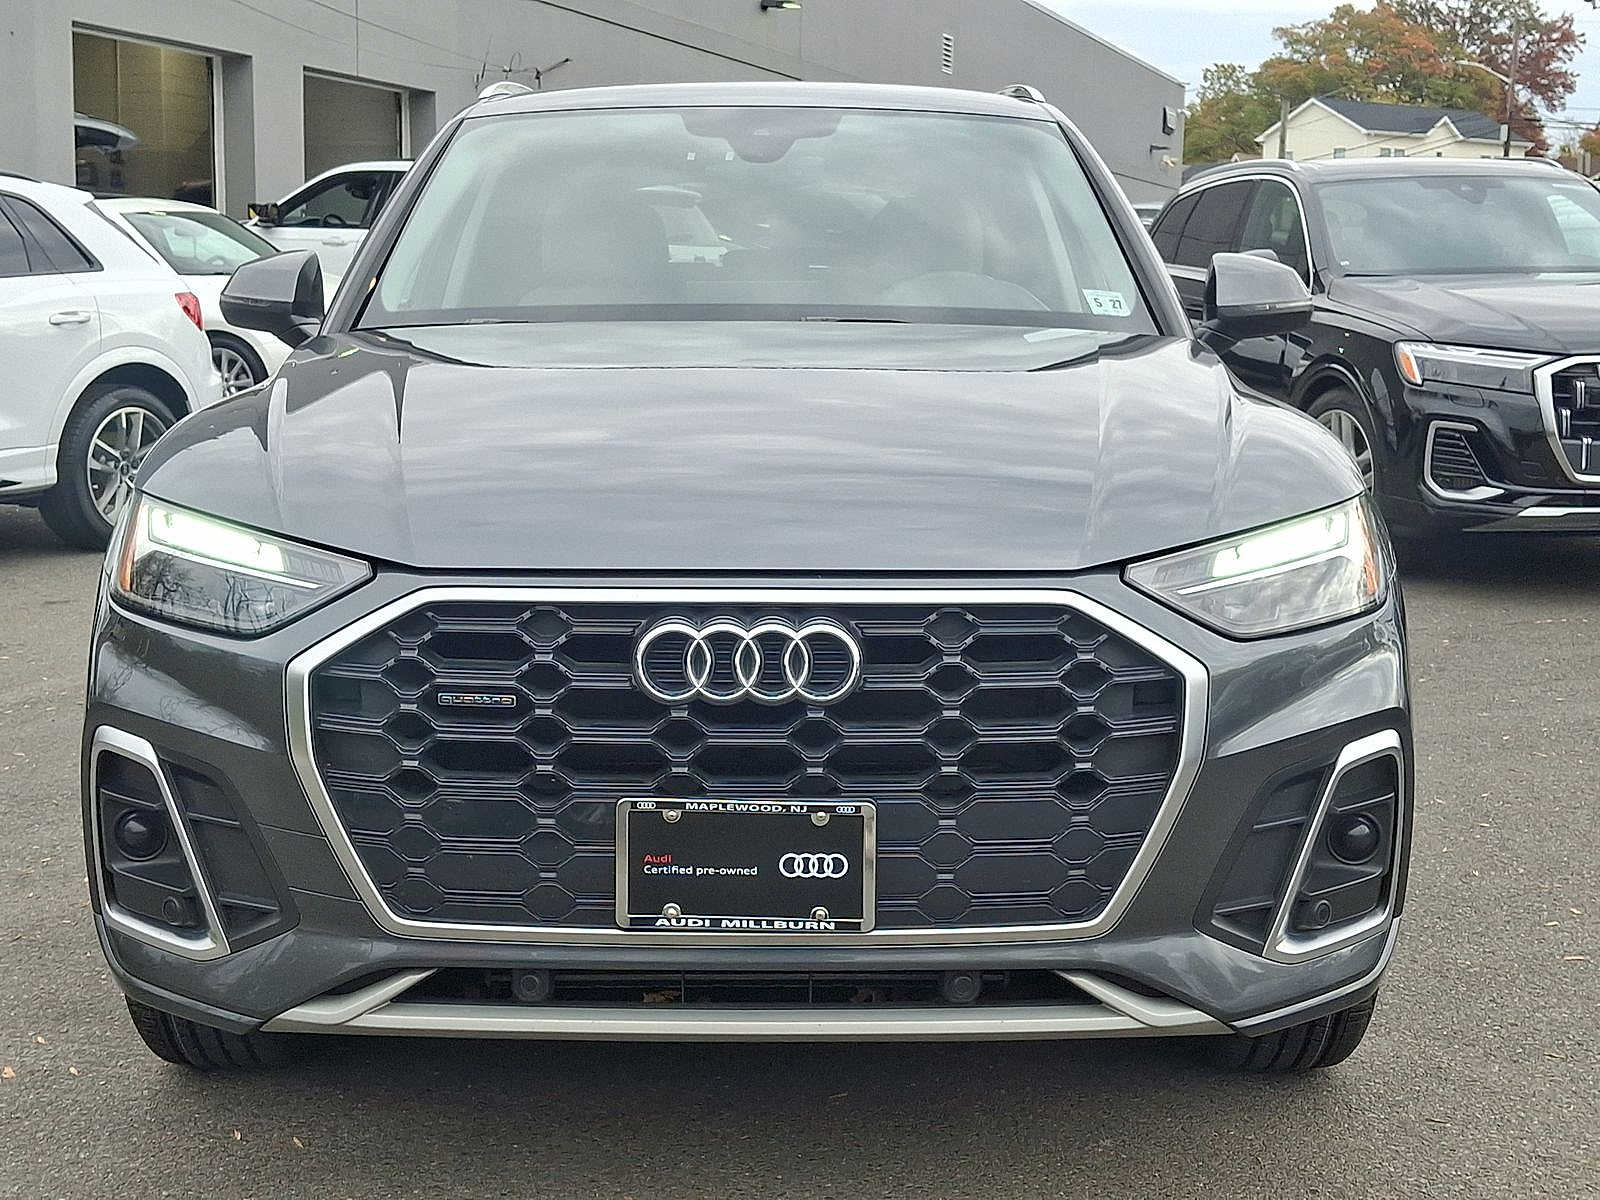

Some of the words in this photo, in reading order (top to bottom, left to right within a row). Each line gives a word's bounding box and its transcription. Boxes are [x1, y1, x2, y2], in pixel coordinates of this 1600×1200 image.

[1109, 299, 1122, 310] 27
[685, 802, 787, 814] MAPLEWOOD,
[790, 805, 808, 813] NJ
[643, 854, 672, 863] Audi
[643, 865, 693, 875] Certified
[696, 866, 758, 877] pre-owned
[654, 917, 710, 928] AUDI
[720, 919, 836, 931] MILLBURN
